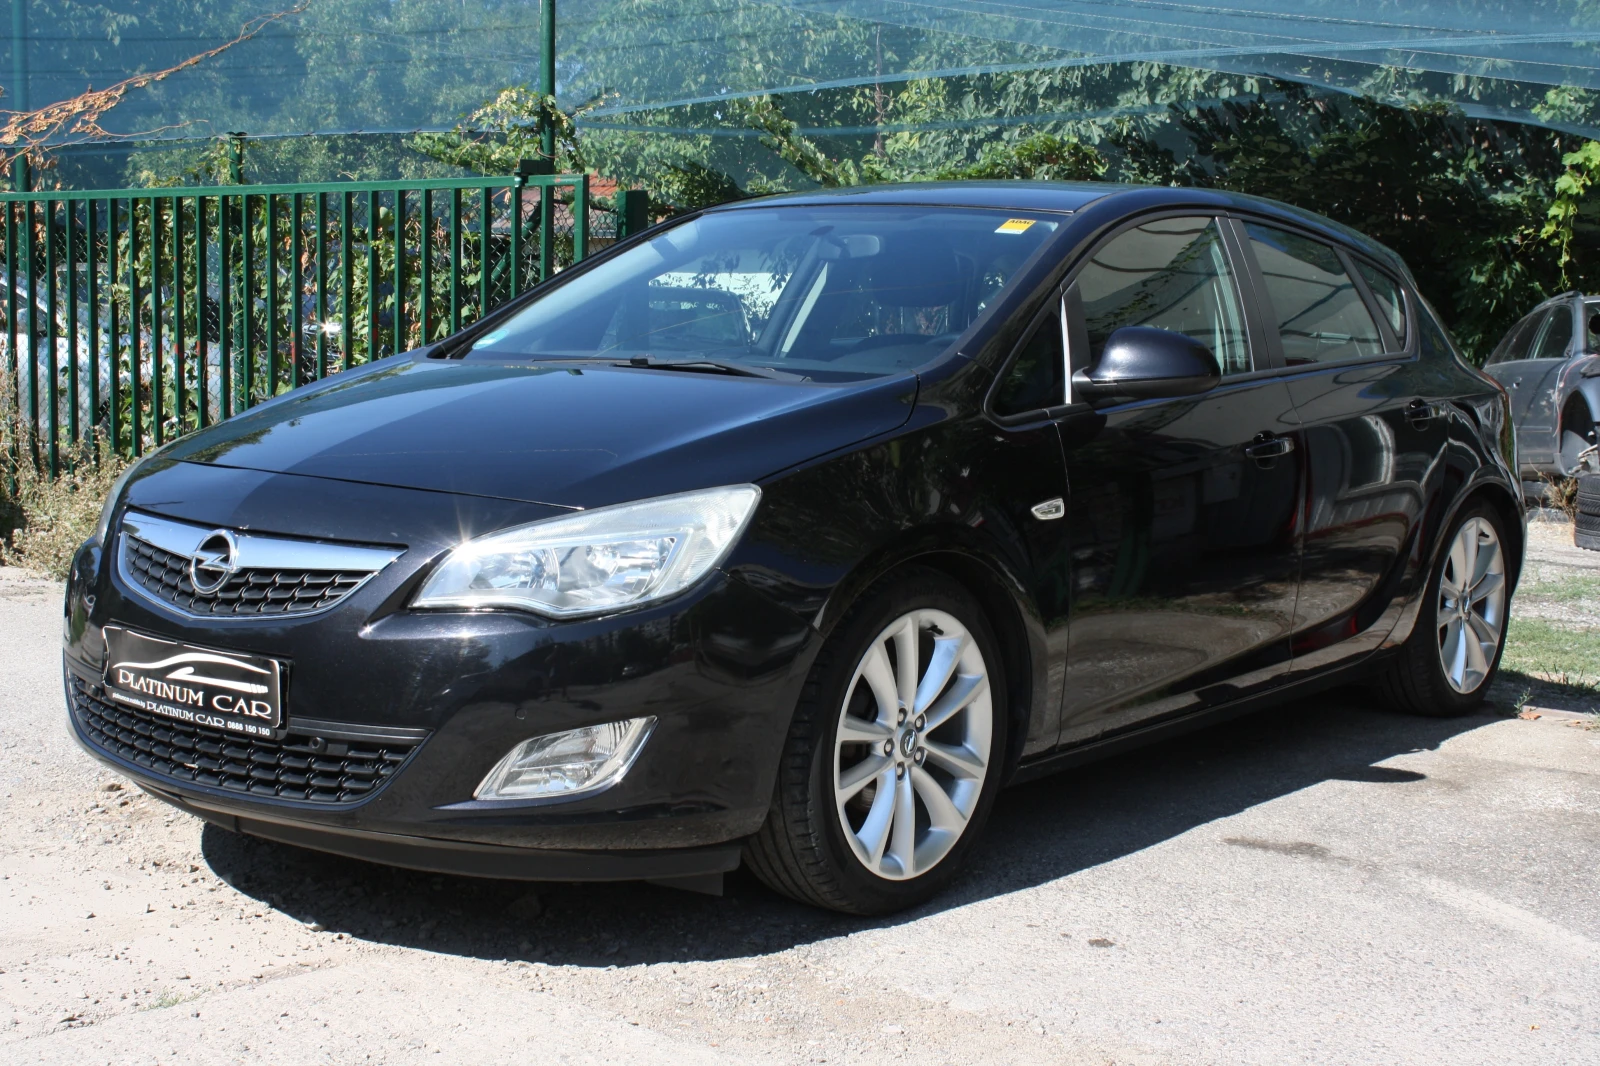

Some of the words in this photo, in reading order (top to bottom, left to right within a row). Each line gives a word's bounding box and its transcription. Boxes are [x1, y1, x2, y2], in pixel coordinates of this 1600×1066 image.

[118, 669, 204, 707] PLATINUM
[212, 695, 272, 719] CAR
[146, 701, 194, 722] PLATINUM
[195, 713, 225, 728] CAR
[245, 724, 257, 733] 150
[258, 726, 270, 736] 150
